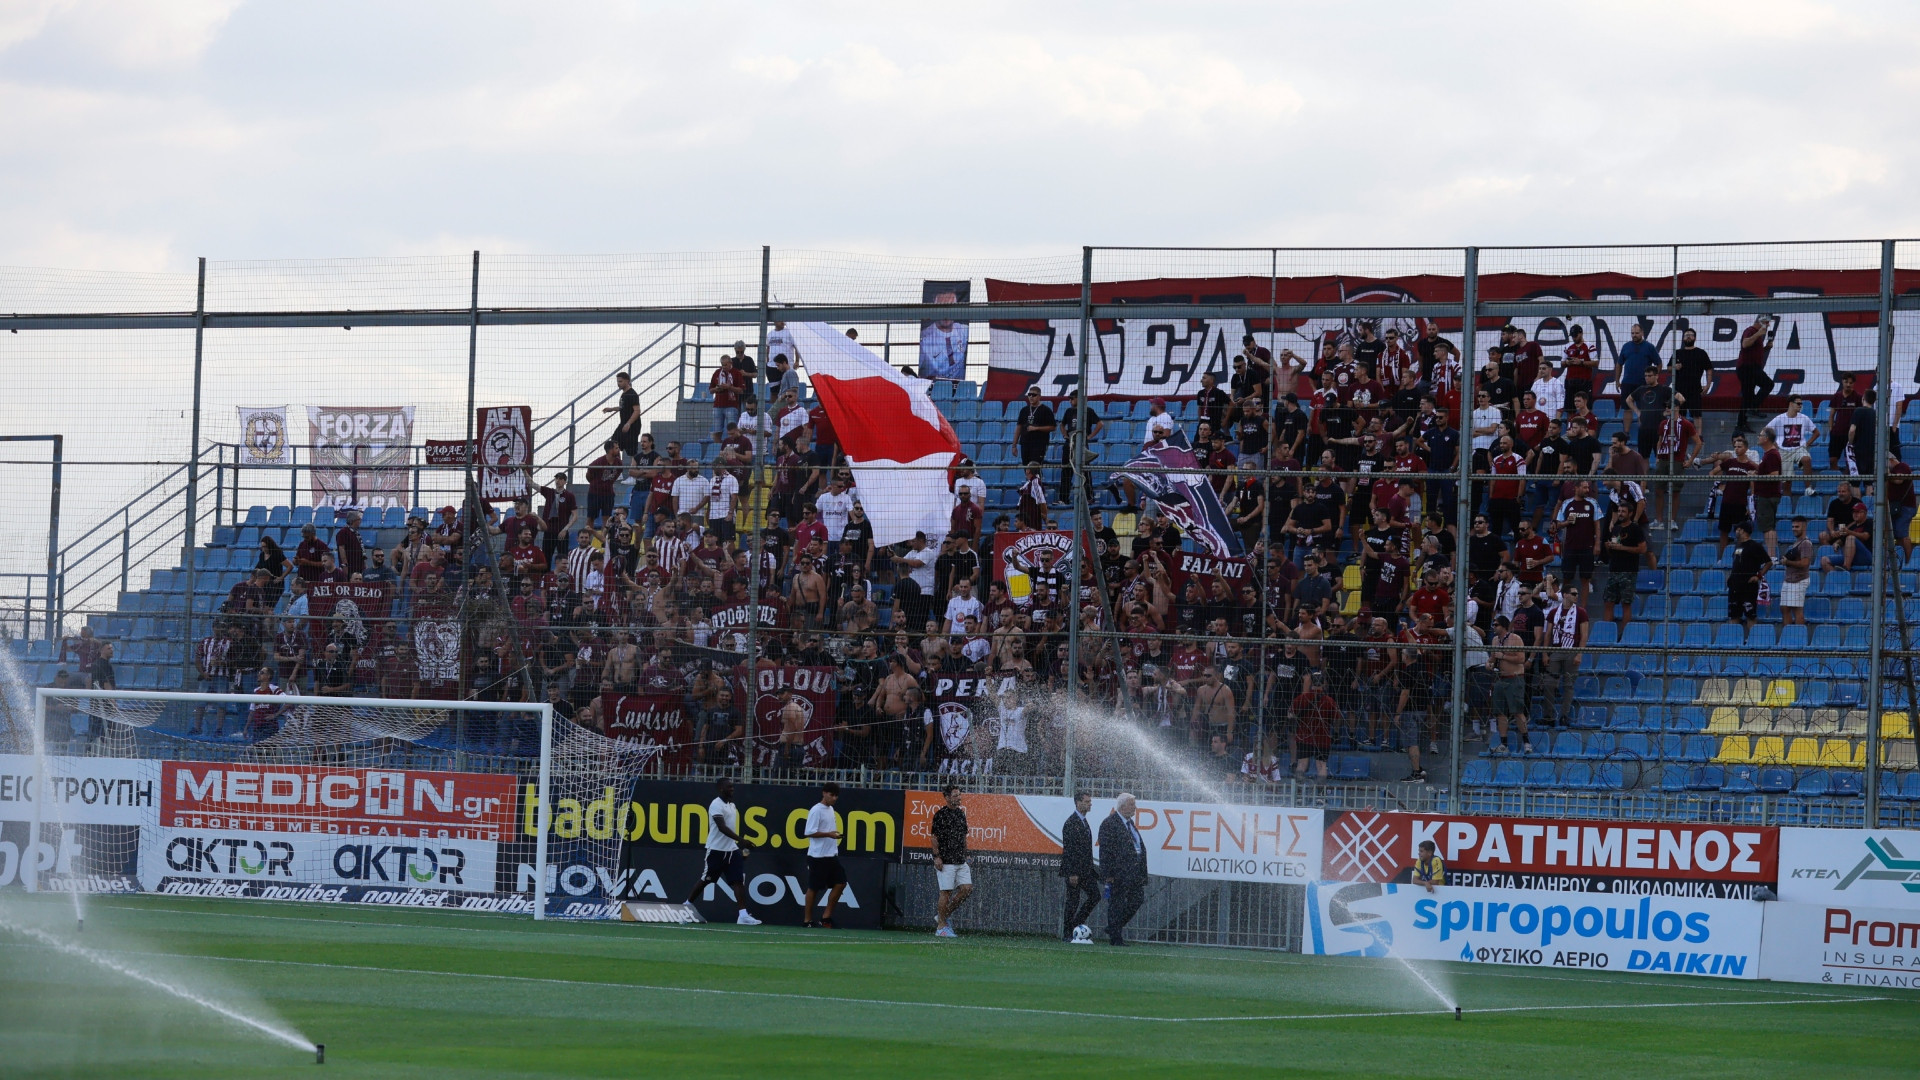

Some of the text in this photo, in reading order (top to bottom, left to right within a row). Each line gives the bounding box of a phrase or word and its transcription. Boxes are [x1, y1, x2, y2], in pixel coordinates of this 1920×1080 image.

[320, 413, 406, 440] FORZA
[1180, 555, 1246, 579] FALANI
[313, 586, 332, 597] AEL
[336, 586, 350, 595] OR
[610, 696, 682, 731] Larissa
[52, 776, 152, 806] ΤΡΟΥΠΗ
[174, 817, 274, 831] SPORTS
[1095, 808, 1308, 857] ΡΣΕΝΗΣ
[1411, 820, 1761, 873] ΚΡΑΤΗΜΕΝΟΣ
[1188, 857, 1257, 874] ΙΔΙΩΤΙΚΟ
[164, 879, 250, 897] novibet
[516, 863, 668, 898] NOVA
[261, 883, 348, 902] novibet
[361, 888, 449, 907] novibet
[461, 893, 549, 913] novibet
[637, 904, 700, 923] novibet
[1413, 896, 1710, 947] spiropoulos
[1476, 947, 1609, 968] ΦΥΣΙΚΟ ΑΕΡΙΟ
[1626, 949, 1748, 976] DAIKIN
[1822, 971, 1833, 983] &
